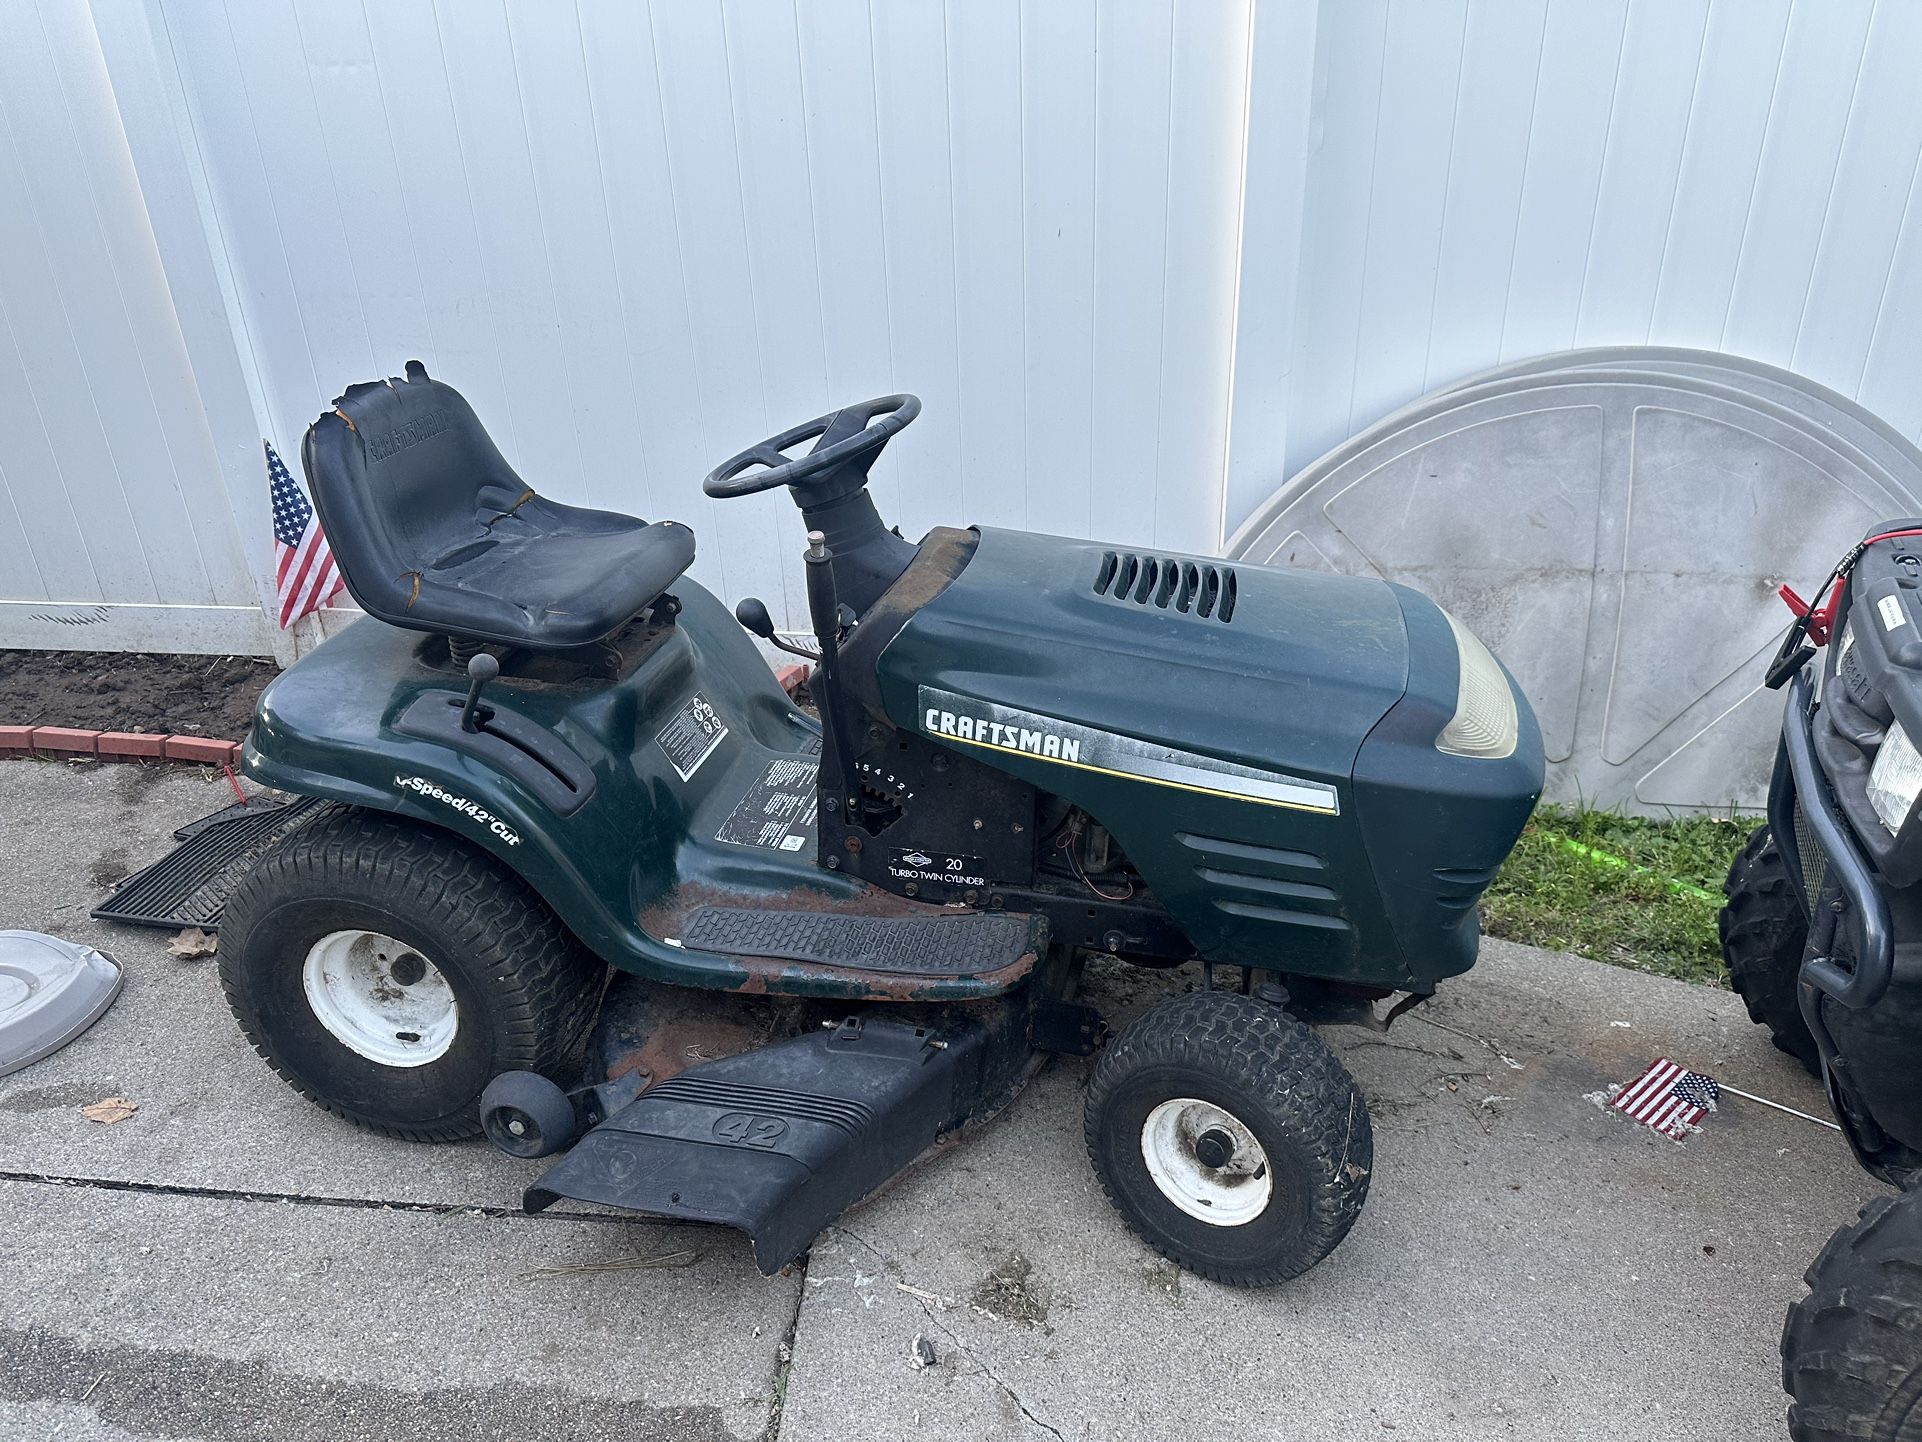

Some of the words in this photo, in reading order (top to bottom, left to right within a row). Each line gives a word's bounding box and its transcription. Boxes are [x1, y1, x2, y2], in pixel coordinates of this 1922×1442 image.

[925, 708, 1081, 763] CRAFTSMAN
[862, 763, 870, 772] 5
[887, 774, 895, 782] 3
[896, 782, 906, 791] 2
[890, 868, 919, 879] TURBO
[920, 871, 943, 881] TWIN
[944, 874, 985, 886] CYLINDER
[945, 858, 963, 871] 20
[718, 1117, 786, 1149] 42
